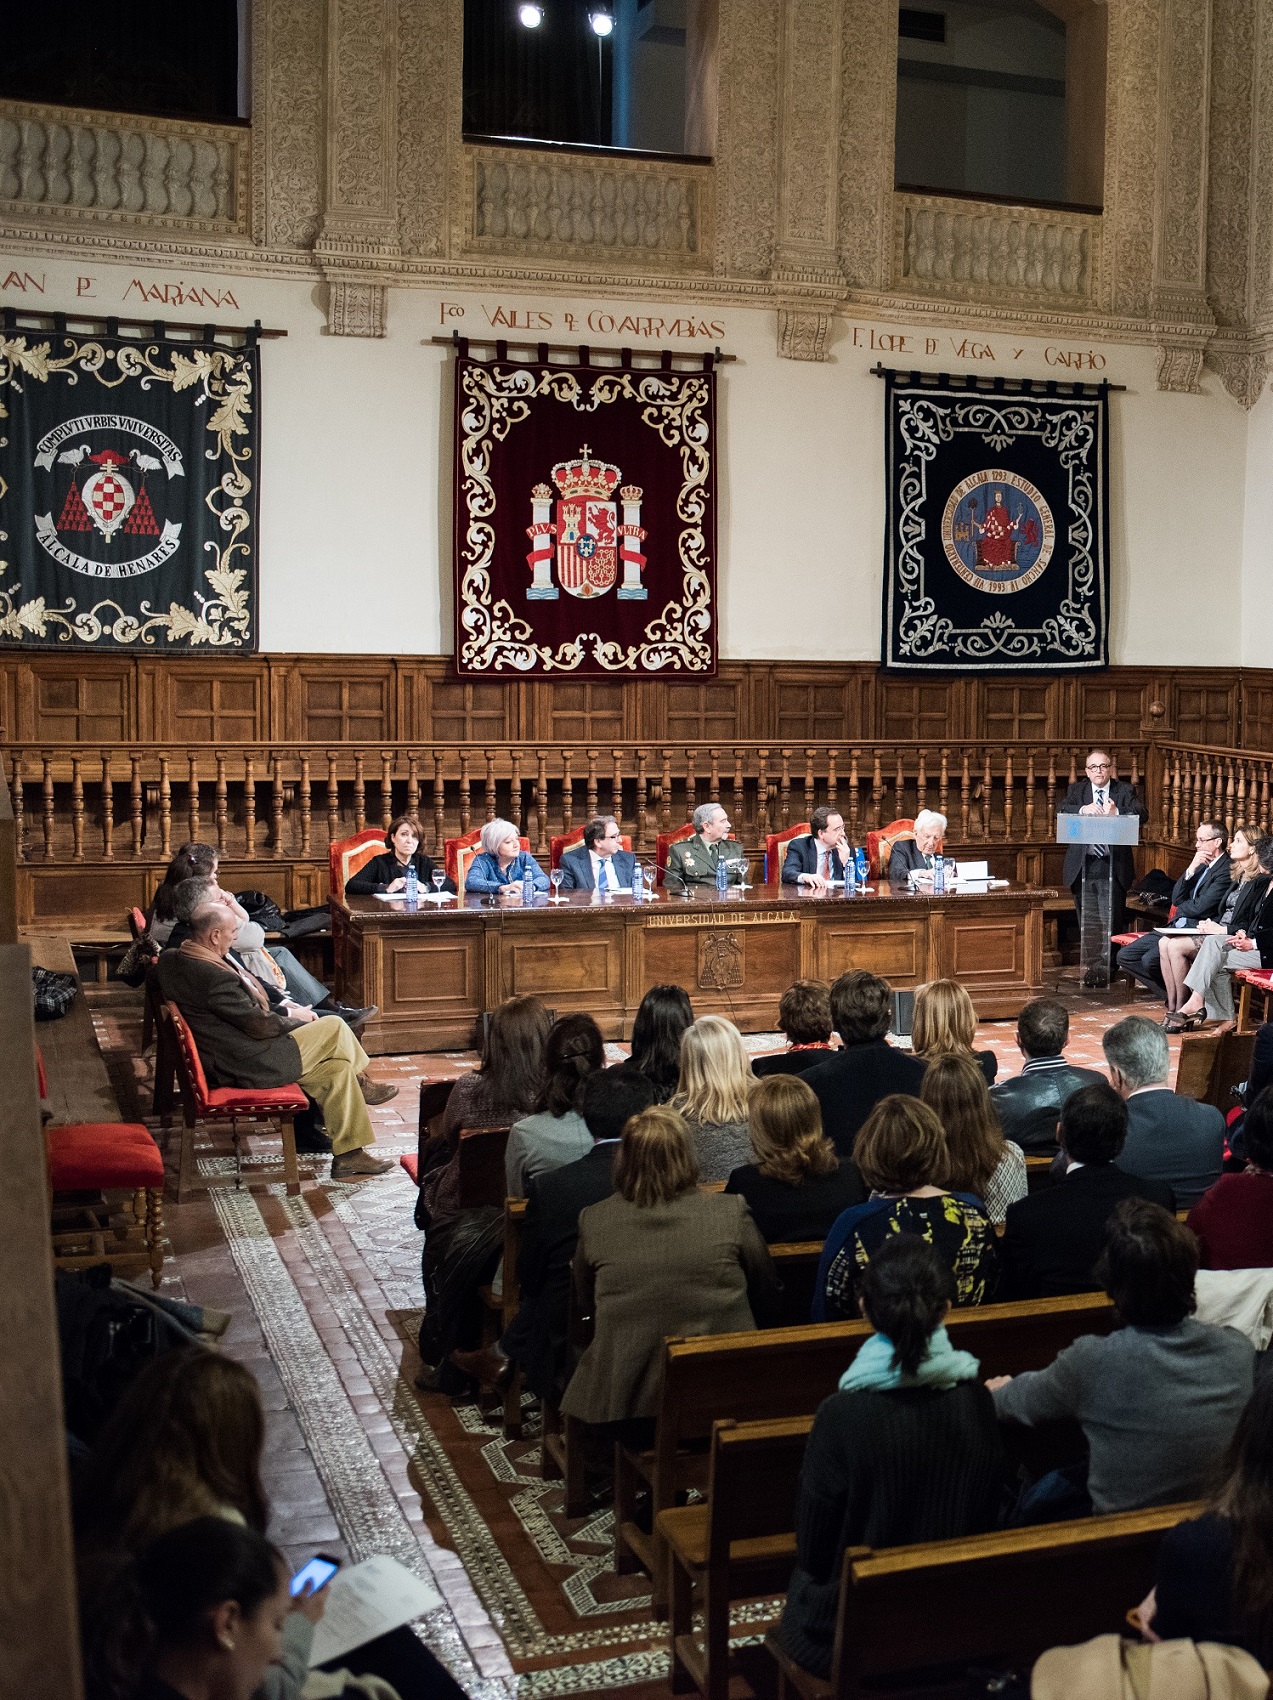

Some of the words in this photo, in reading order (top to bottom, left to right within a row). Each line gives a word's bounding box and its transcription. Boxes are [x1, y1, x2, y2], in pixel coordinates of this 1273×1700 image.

[950, 336, 996, 361] VEGA
[1044, 346, 1107, 371] CARPIO
[84, 416, 118, 430] VRBIS
[119, 416, 181, 461] VNIVERSITAS
[991, 470, 1007, 482] 1293
[1010, 476, 1041, 503] ESTUDIO
[526, 523, 558, 538] PLVS
[617, 525, 647, 540] VLTRA
[1039, 504, 1055, 540] GENERAL
[40, 534, 89, 573] ALCALA
[94, 564, 112, 577] DE
[118, 538, 176, 577] HENARES
[1043, 544, 1052, 556] DE
[1023, 559, 1047, 586] SANCHO
[988, 582, 1006, 593] 1993
[649, 913, 725, 926] UNIVERSIDAD
[730, 911, 746, 922] DE
[752, 910, 796, 921] ALCALA
